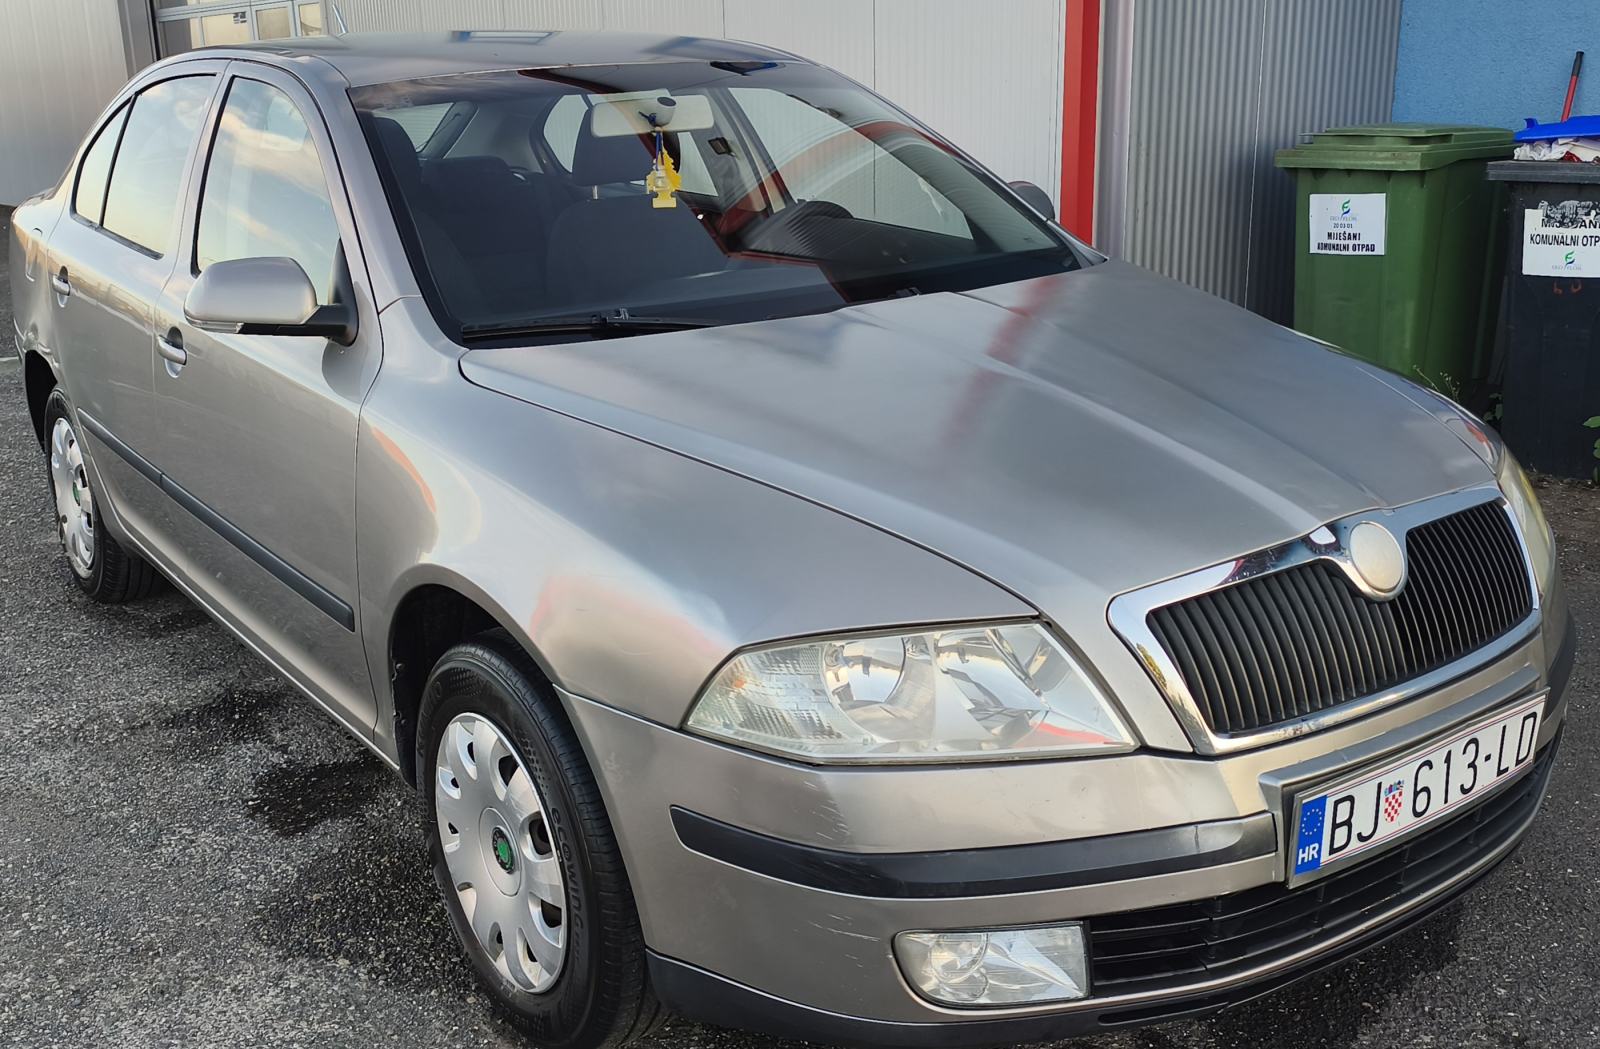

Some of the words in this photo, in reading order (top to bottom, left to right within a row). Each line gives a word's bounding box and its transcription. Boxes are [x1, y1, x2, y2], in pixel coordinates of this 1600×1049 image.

[1327, 231, 1361, 241] MIJEŠANI
[1529, 233, 1579, 247] KOMUNALNI
[1317, 242, 1350, 252] KOMUNALNI
[1352, 243, 1376, 252] OTPAD
[1328, 781, 1383, 856] BJ
[1411, 711, 1538, 818] 613-LD
[1297, 843, 1319, 865] HR
